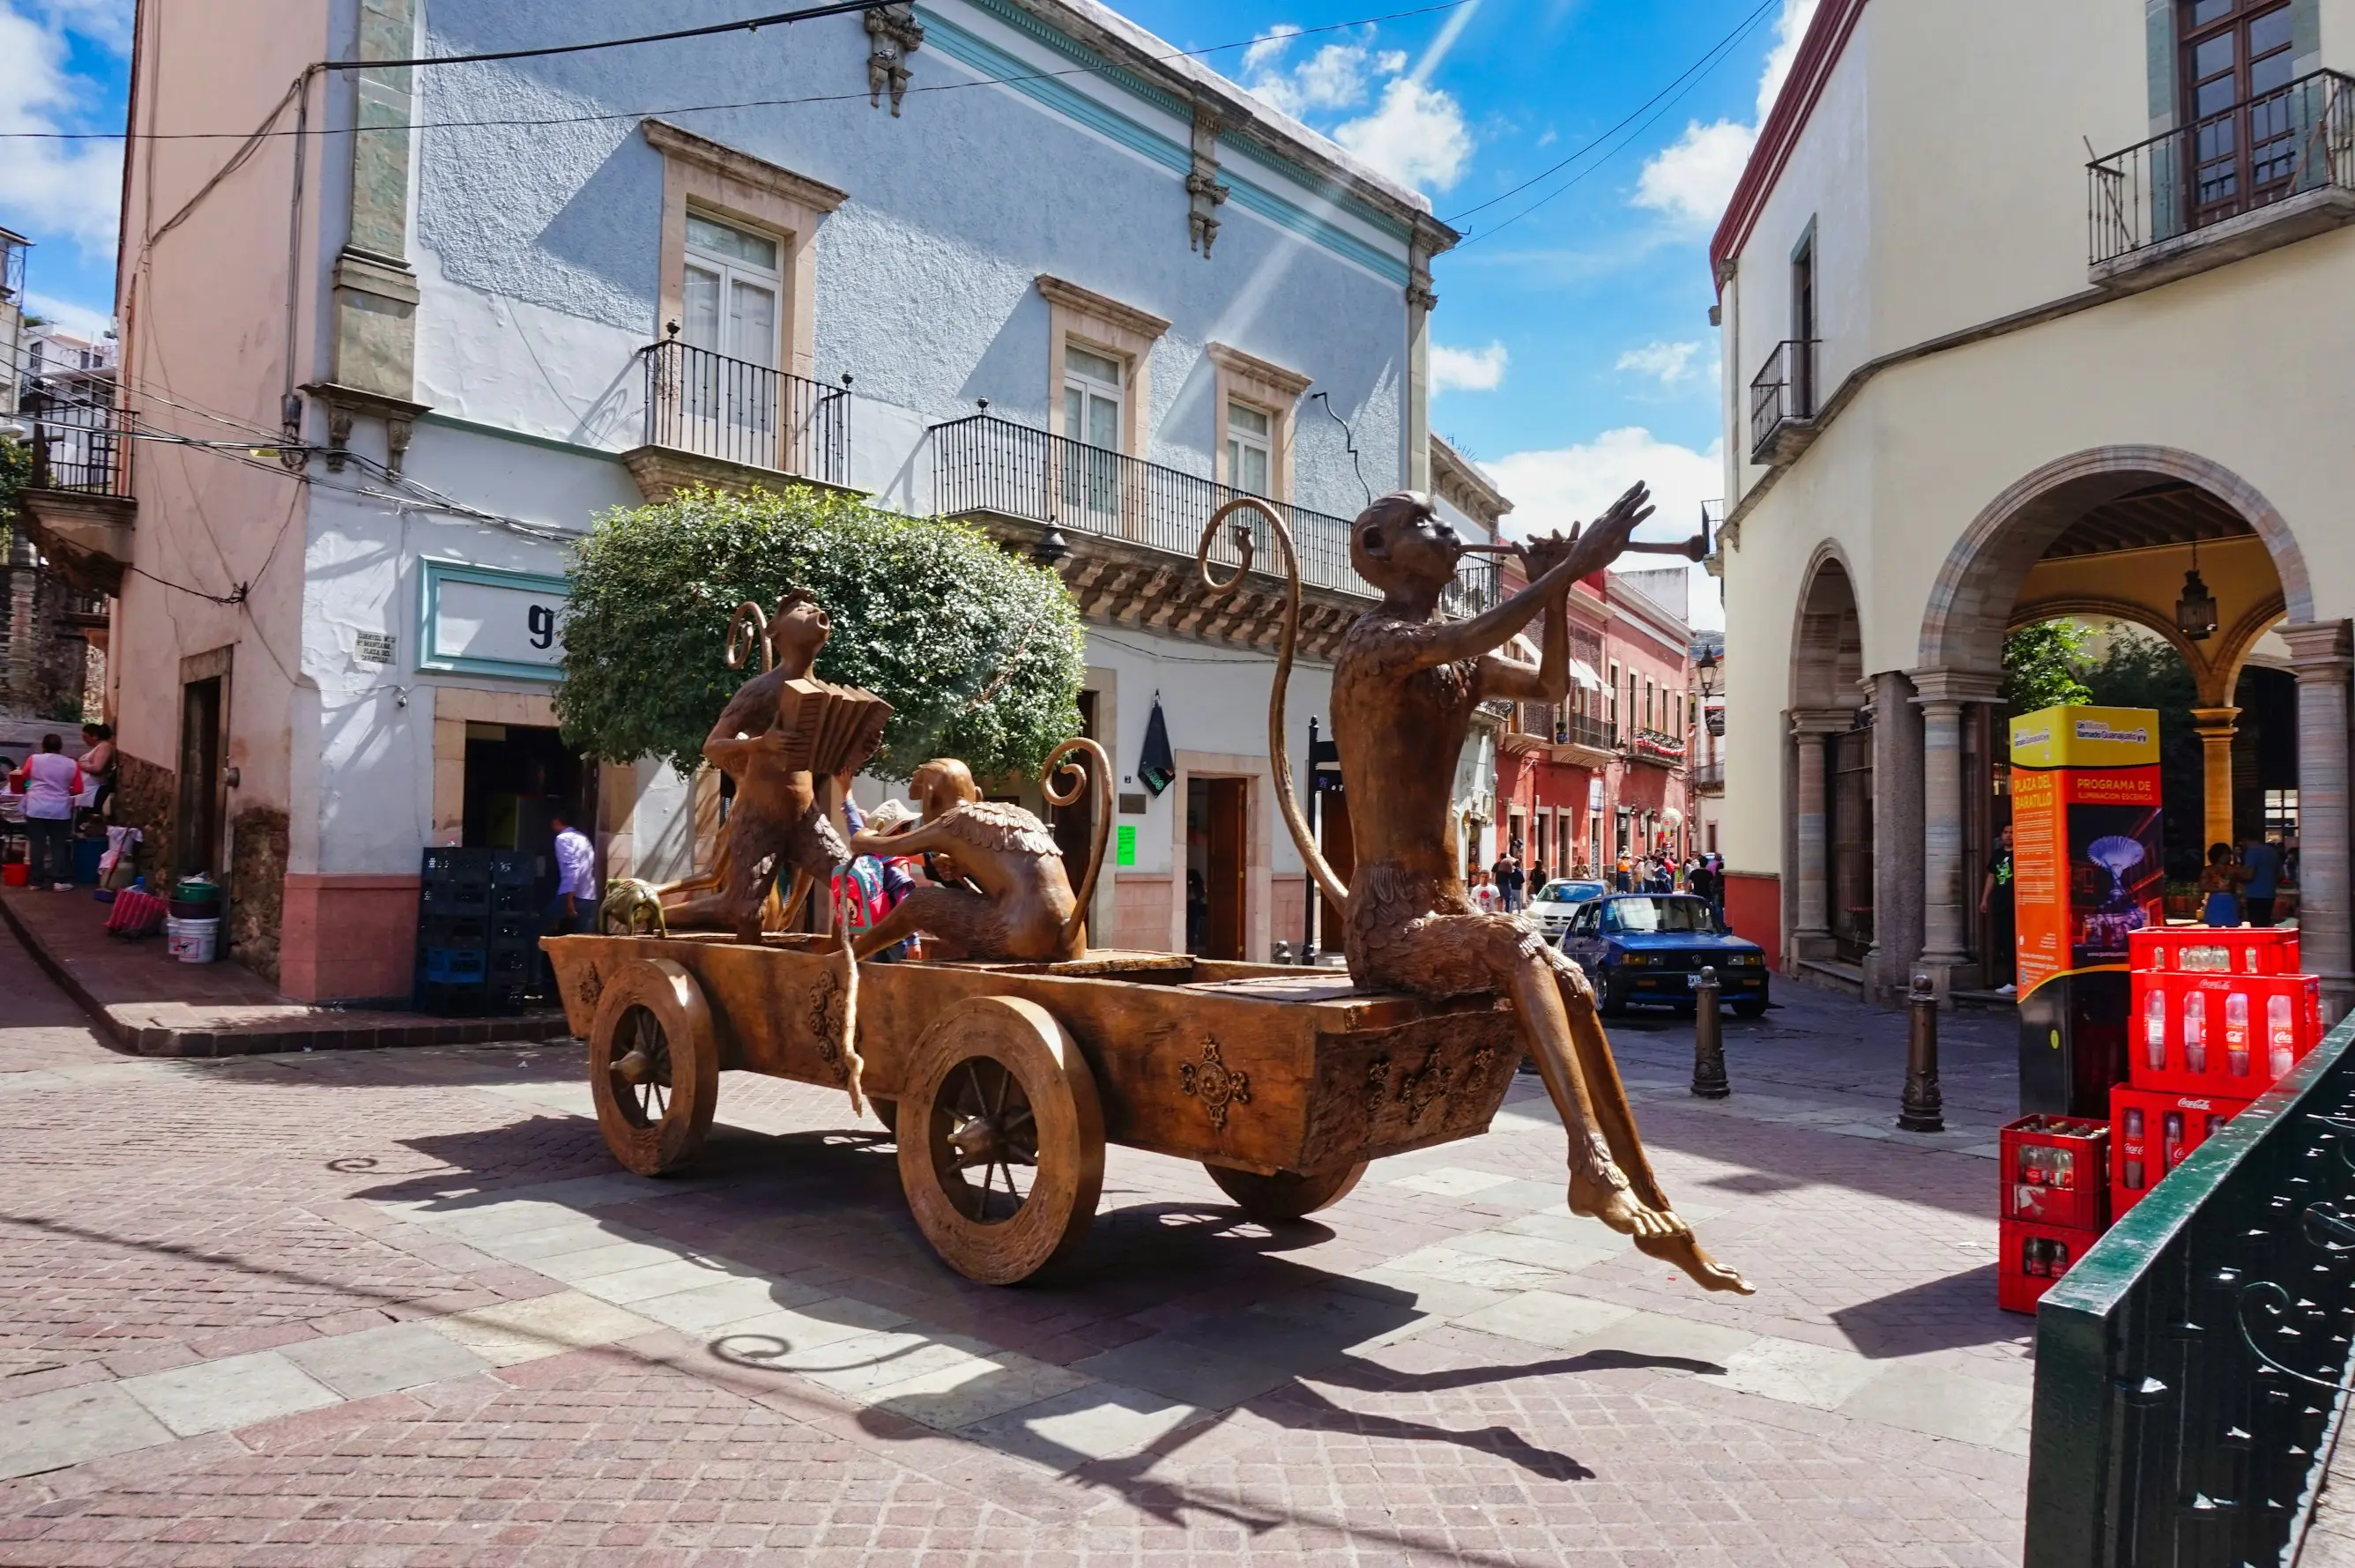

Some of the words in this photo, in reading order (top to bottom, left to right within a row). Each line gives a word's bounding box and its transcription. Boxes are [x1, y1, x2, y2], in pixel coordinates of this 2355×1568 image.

[529, 605, 553, 649] g
[2101, 731, 2136, 742] Guanajuato
[2014, 777, 2037, 792] PLAZA
[2038, 775, 2052, 789] DEL
[2077, 778, 2135, 790] PROGRAMA
[2138, 781, 2151, 791] DE
[2015, 792, 2052, 810] BARATILLO
[2177, 1097, 2211, 1111] Coca-Cola
